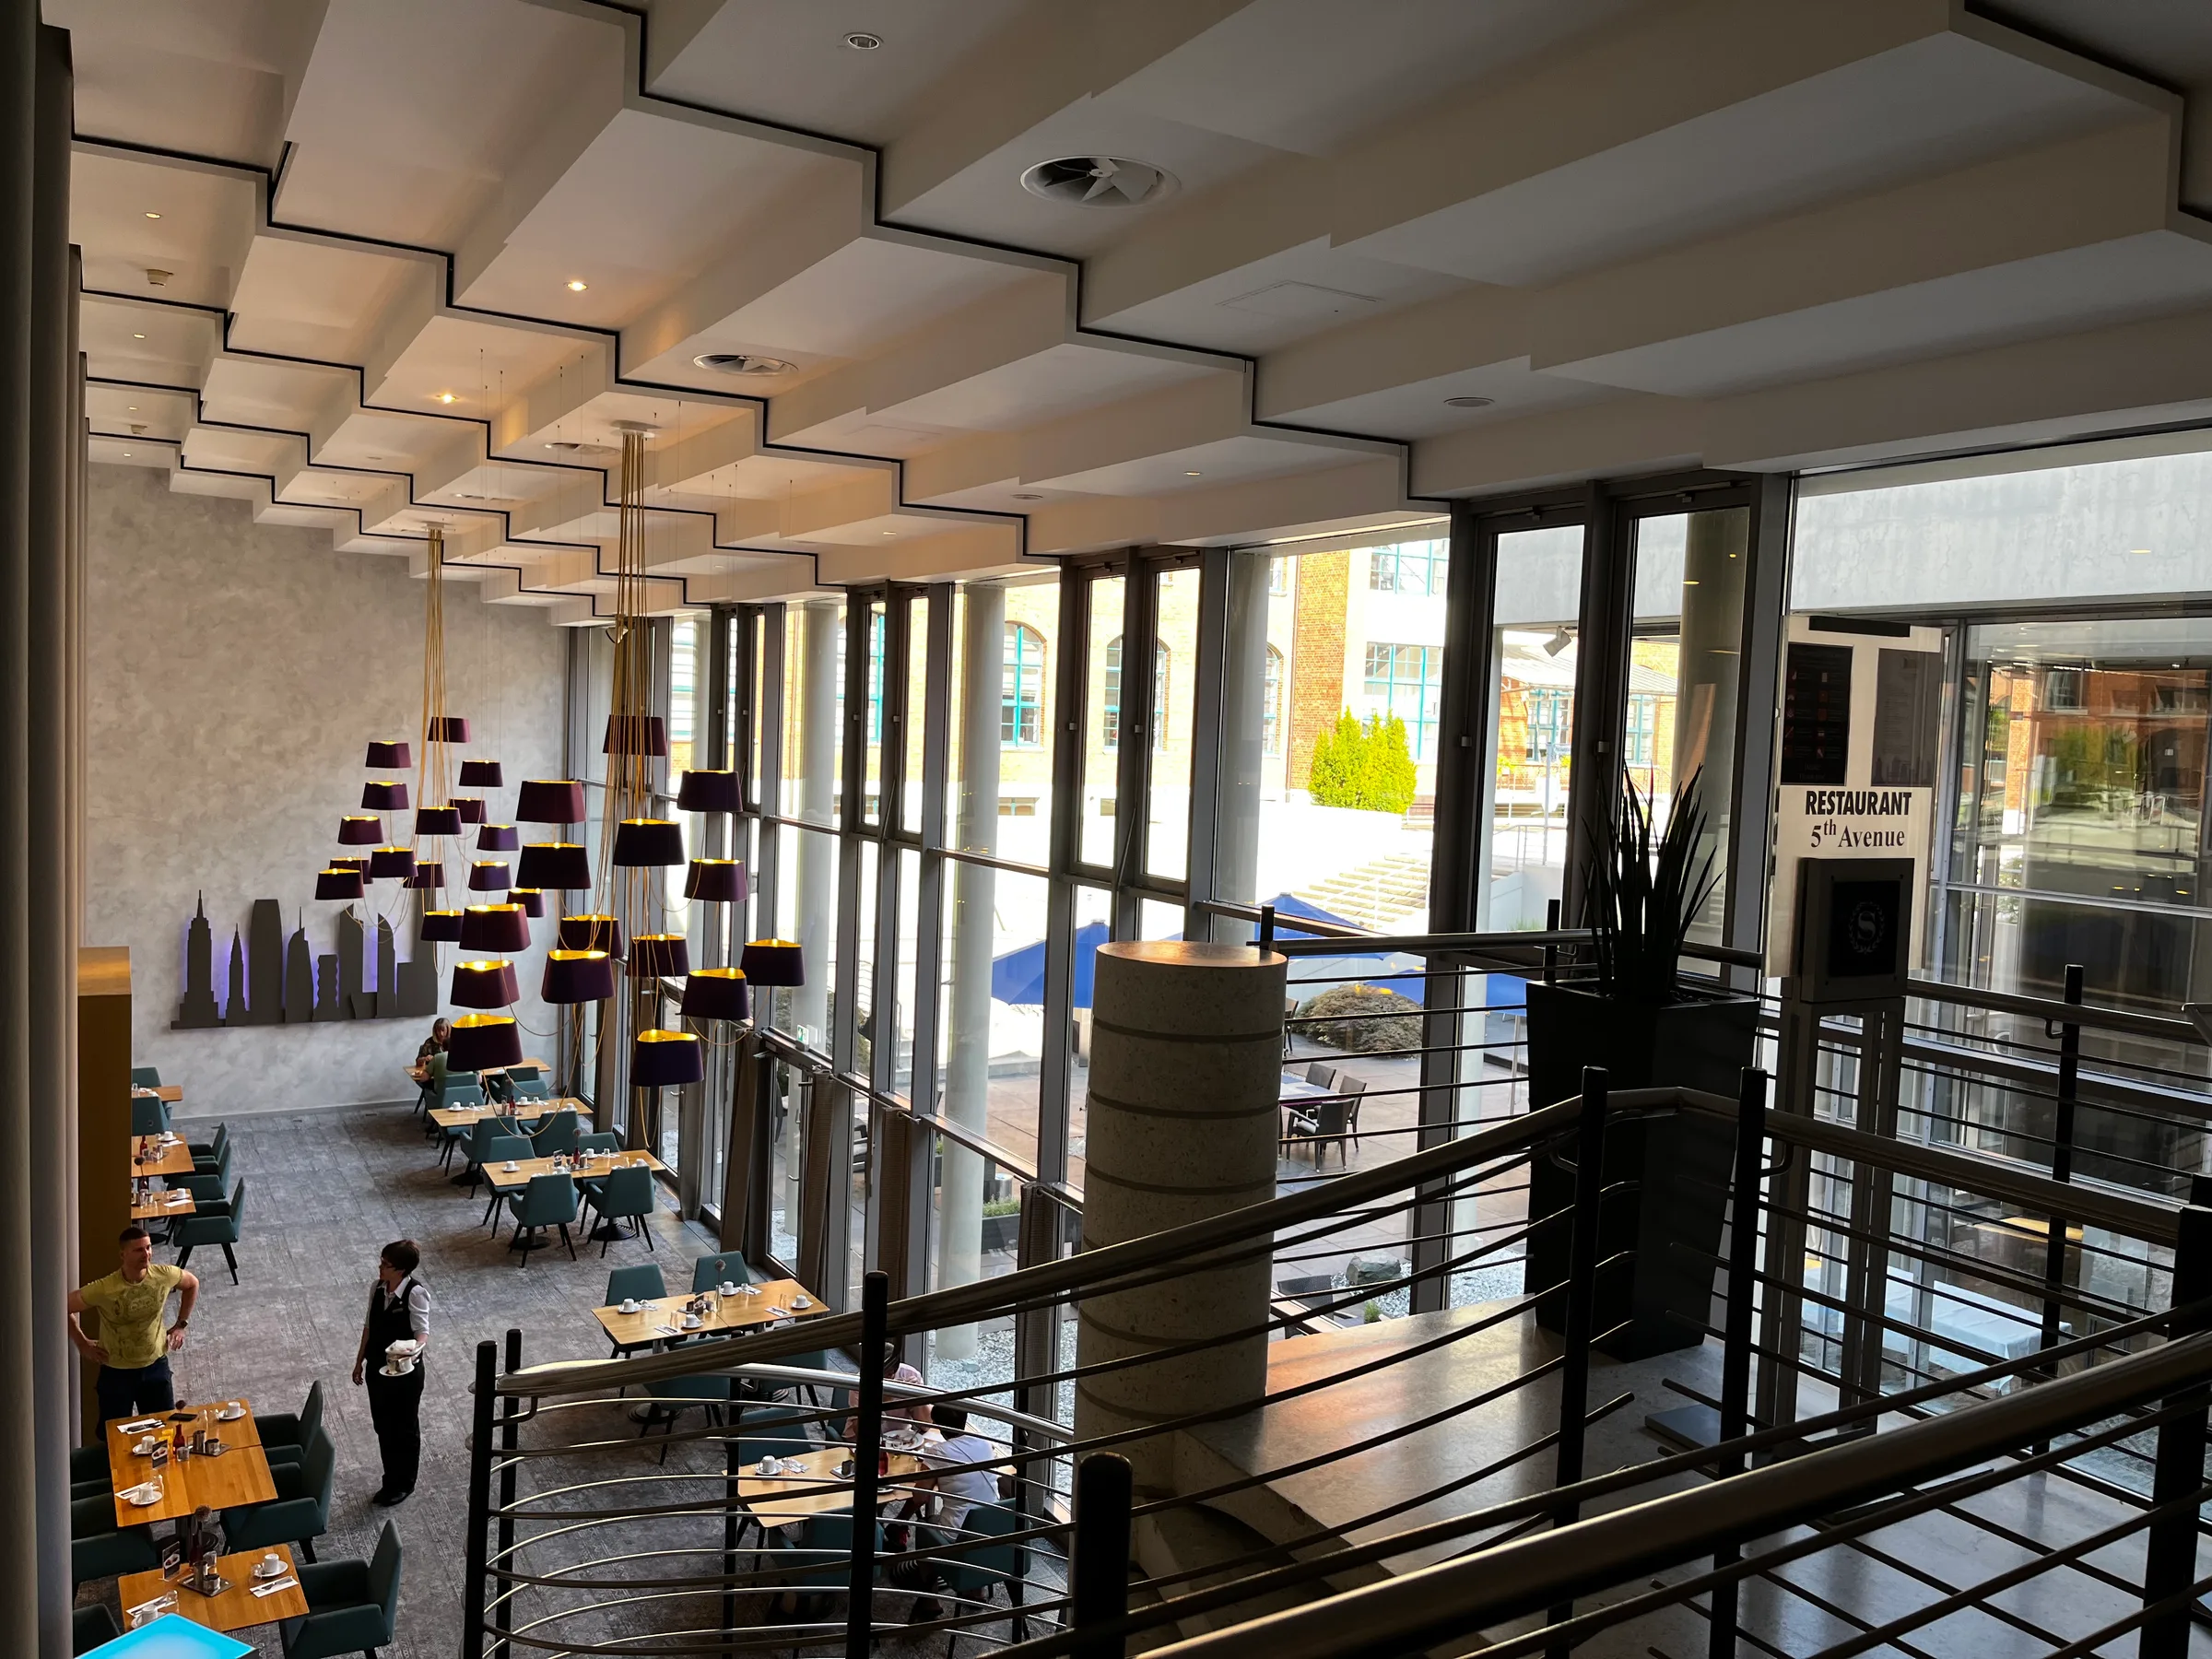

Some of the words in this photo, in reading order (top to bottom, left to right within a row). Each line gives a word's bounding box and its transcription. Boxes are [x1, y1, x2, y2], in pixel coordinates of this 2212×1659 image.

[1806, 790, 1912, 816] RESTAURANT
[1810, 818, 1837, 848] 5th
[1838, 826, 1905, 848] Avenue
[1858, 911, 1877, 941] S
